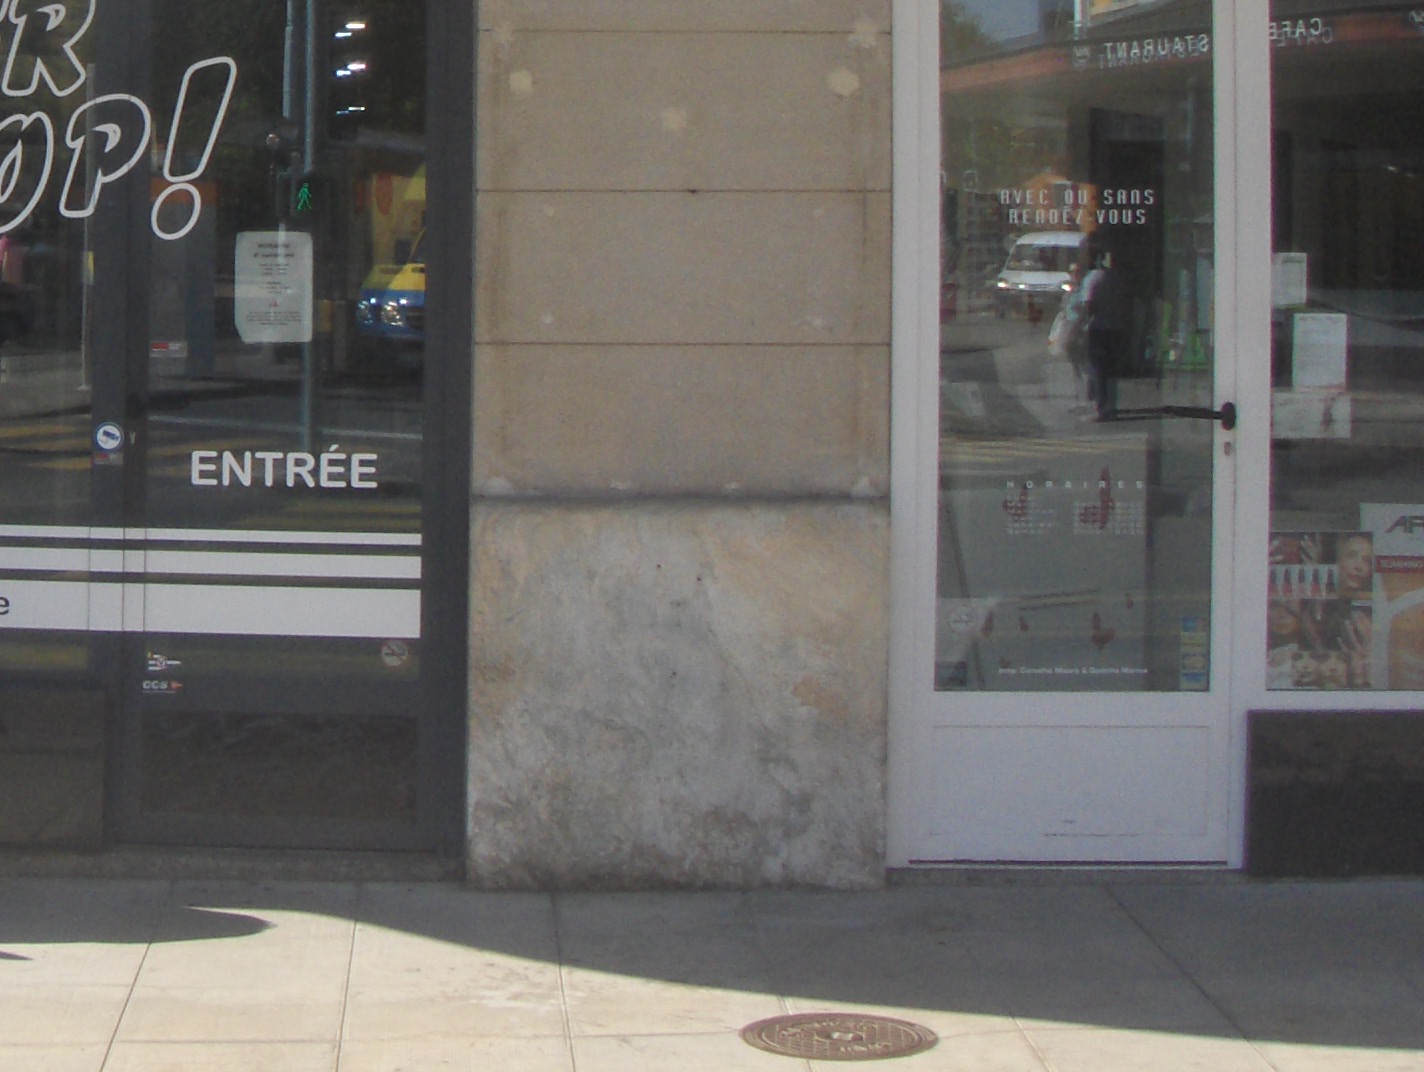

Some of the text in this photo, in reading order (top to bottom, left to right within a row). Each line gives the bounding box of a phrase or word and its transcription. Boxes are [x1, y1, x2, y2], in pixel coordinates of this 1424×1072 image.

[1000, 188, 1049, 205] AVEC
[1063, 188, 1089, 205] OU
[190, 443, 379, 489] ENTRÉE
